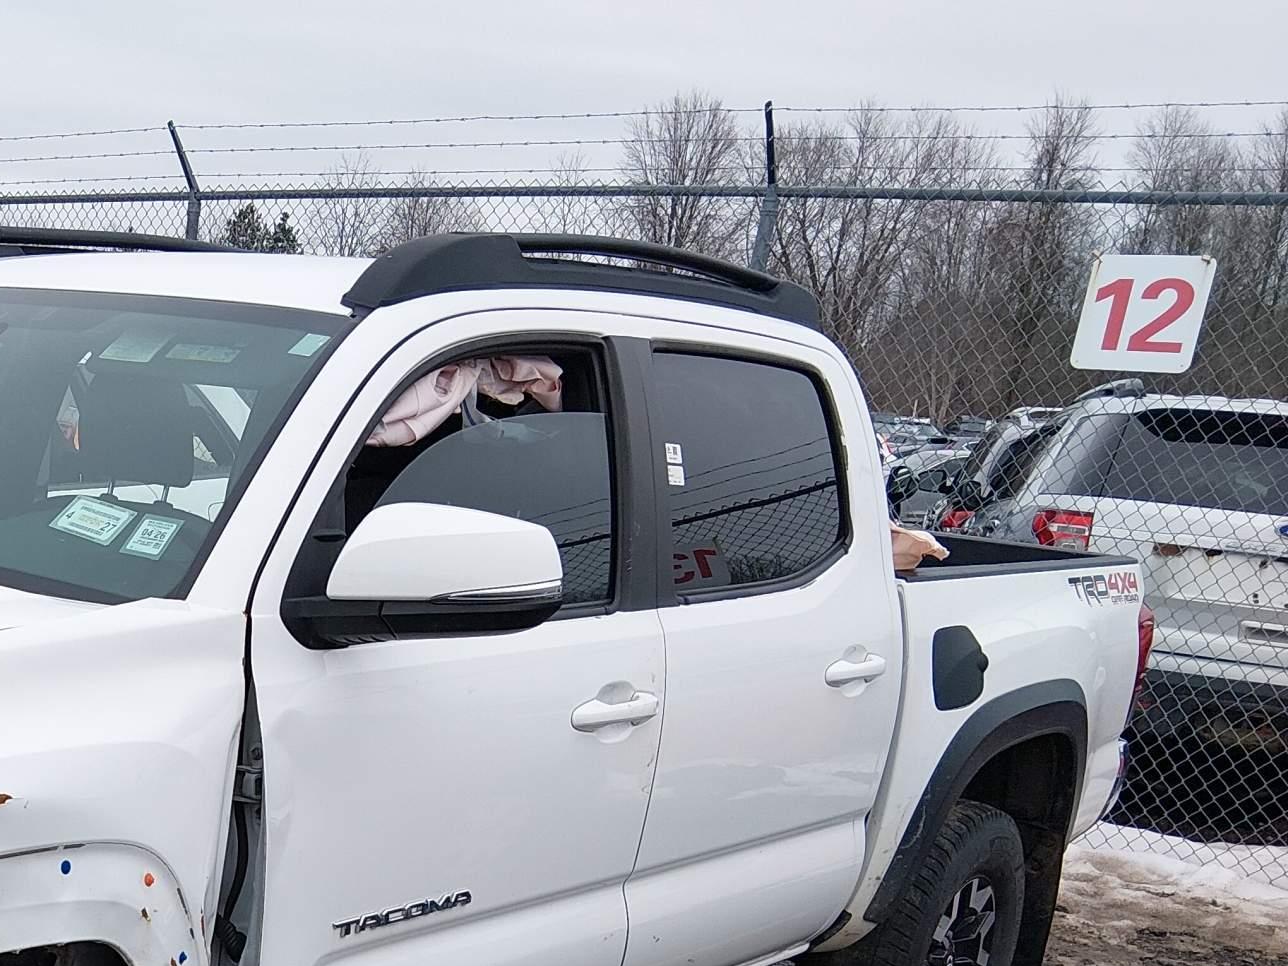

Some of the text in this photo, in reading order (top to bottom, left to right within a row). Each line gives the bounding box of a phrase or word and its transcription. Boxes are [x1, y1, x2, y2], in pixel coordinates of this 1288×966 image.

[1095, 277, 1195, 354] 12
[99, 521, 118, 534] 27
[1068, 574, 1109, 608] TRD
[331, 888, 472, 938] TACOMA
